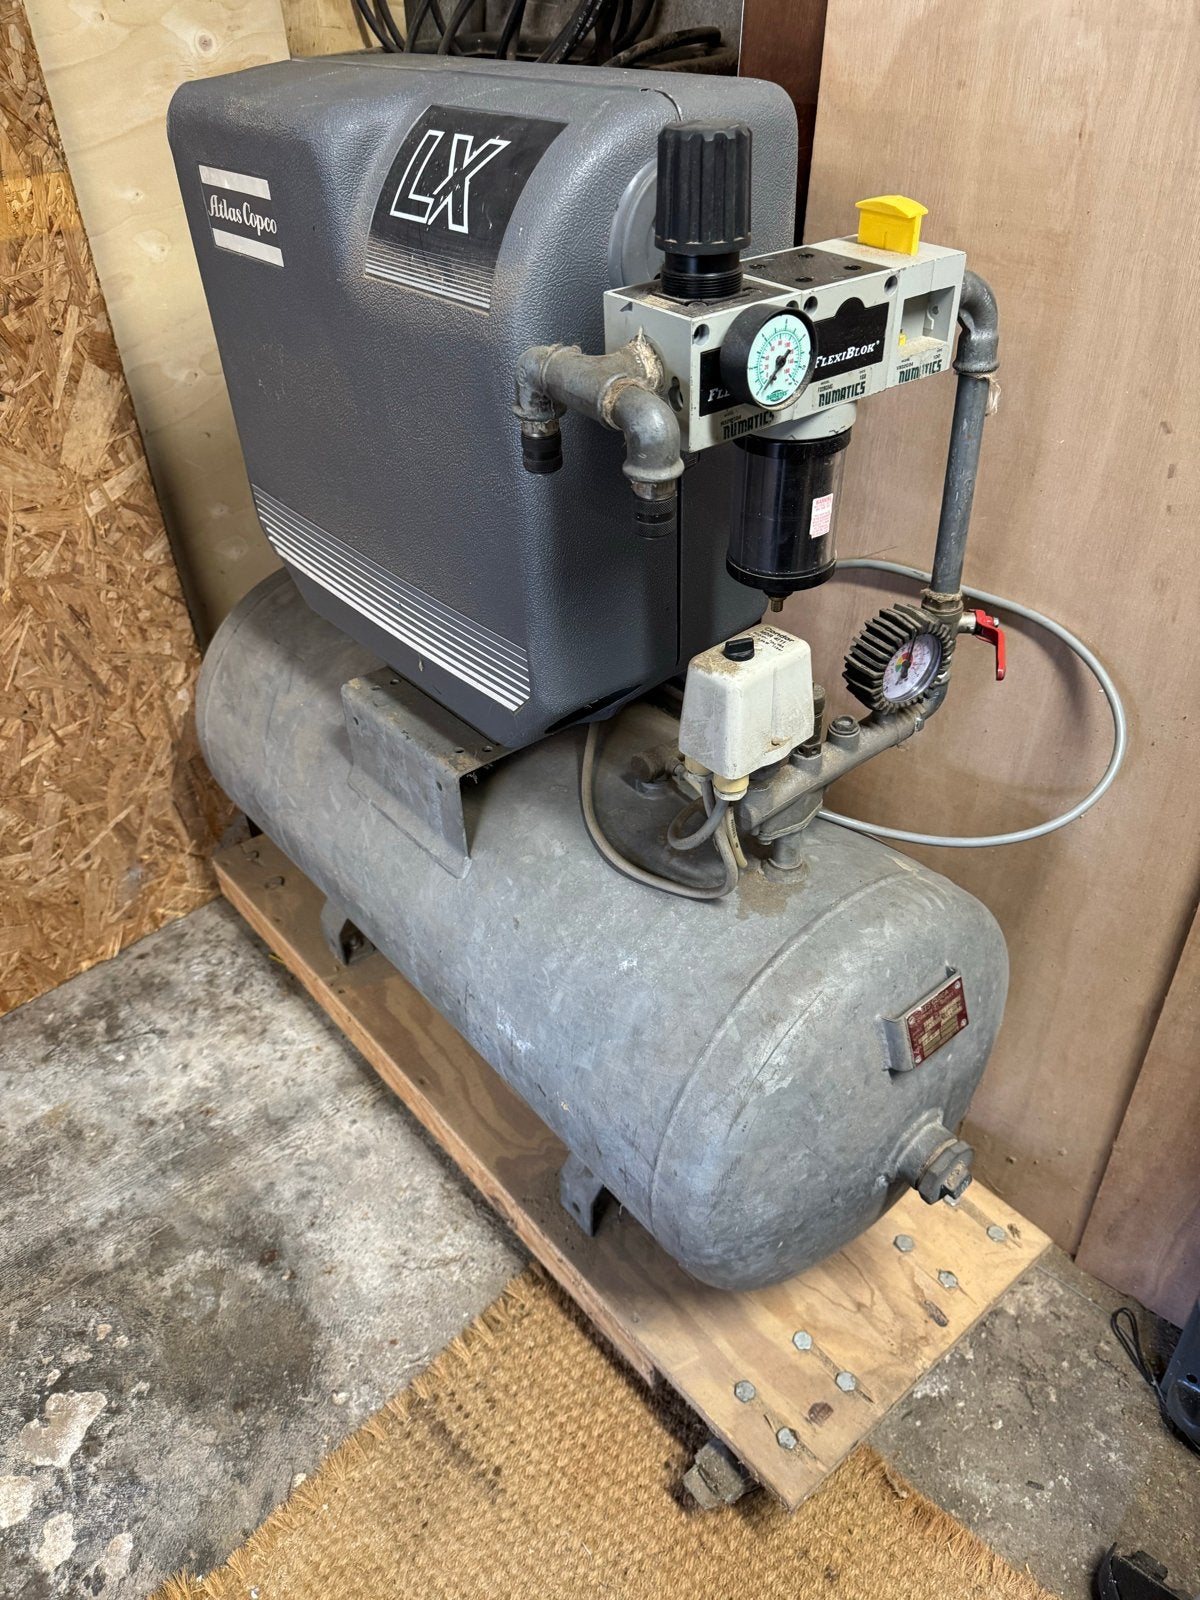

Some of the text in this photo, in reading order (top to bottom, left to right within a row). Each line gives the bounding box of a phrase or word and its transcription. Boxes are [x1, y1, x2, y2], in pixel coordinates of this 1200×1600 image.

[208, 194, 277, 236] Atlas Copco
[389, 129, 512, 234] LX
